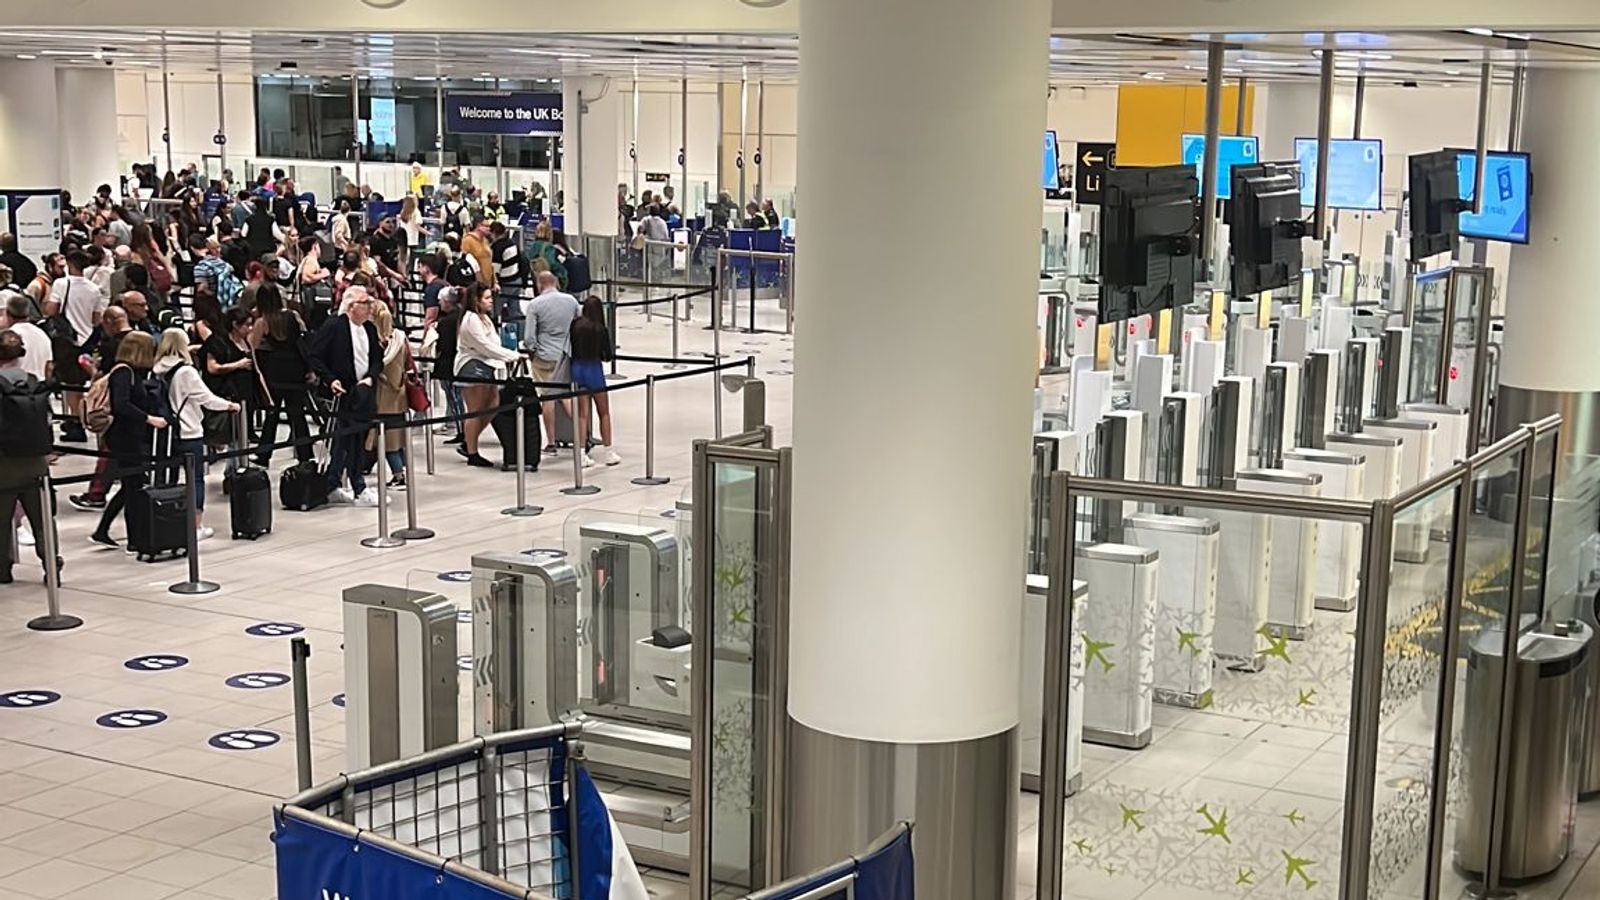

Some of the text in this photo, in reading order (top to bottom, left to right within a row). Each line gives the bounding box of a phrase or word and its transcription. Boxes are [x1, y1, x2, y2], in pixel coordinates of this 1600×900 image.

[459, 107, 502, 119] Welcome
[504, 109, 513, 120] to
[515, 108, 531, 120] the
[533, 108, 549, 120] UK
